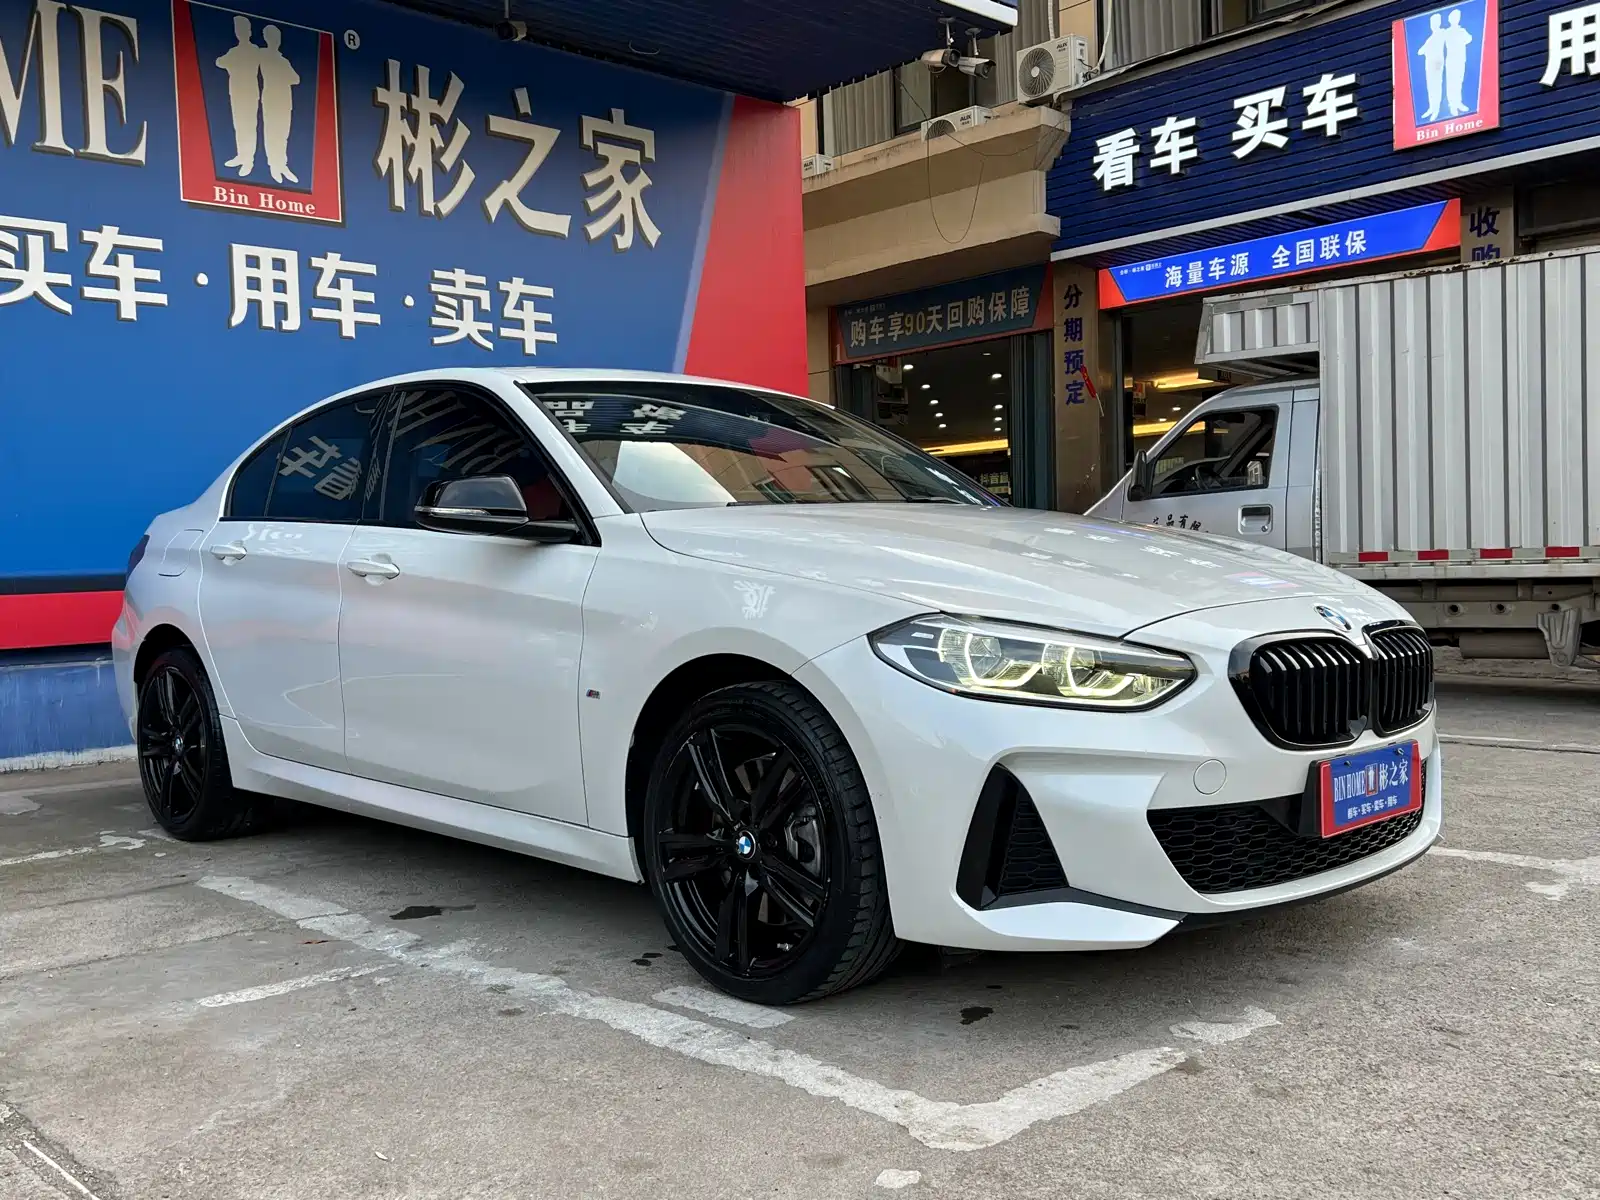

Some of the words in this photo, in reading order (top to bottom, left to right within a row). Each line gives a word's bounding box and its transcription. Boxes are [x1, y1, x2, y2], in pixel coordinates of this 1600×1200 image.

[373, 57, 662, 252] 彬之家
[1093, 115, 1199, 191] 看车
[1232, 72, 1360, 159] 买车
[1416, 128, 1439, 142] Bin
[1445, 118, 1484, 135] Home
[213, 184, 249, 207] Bin
[258, 192, 317, 215] Home
[1165, 252, 1250, 288] 海量车源
[1272, 229, 1367, 269] 全国联保
[850, 286, 1030, 348] 购车享90天回购保障
[1063, 283, 1085, 405] 分期预定
[1347, 770, 1366, 799] HOME
[1379, 758, 1408, 791] 彬之家
